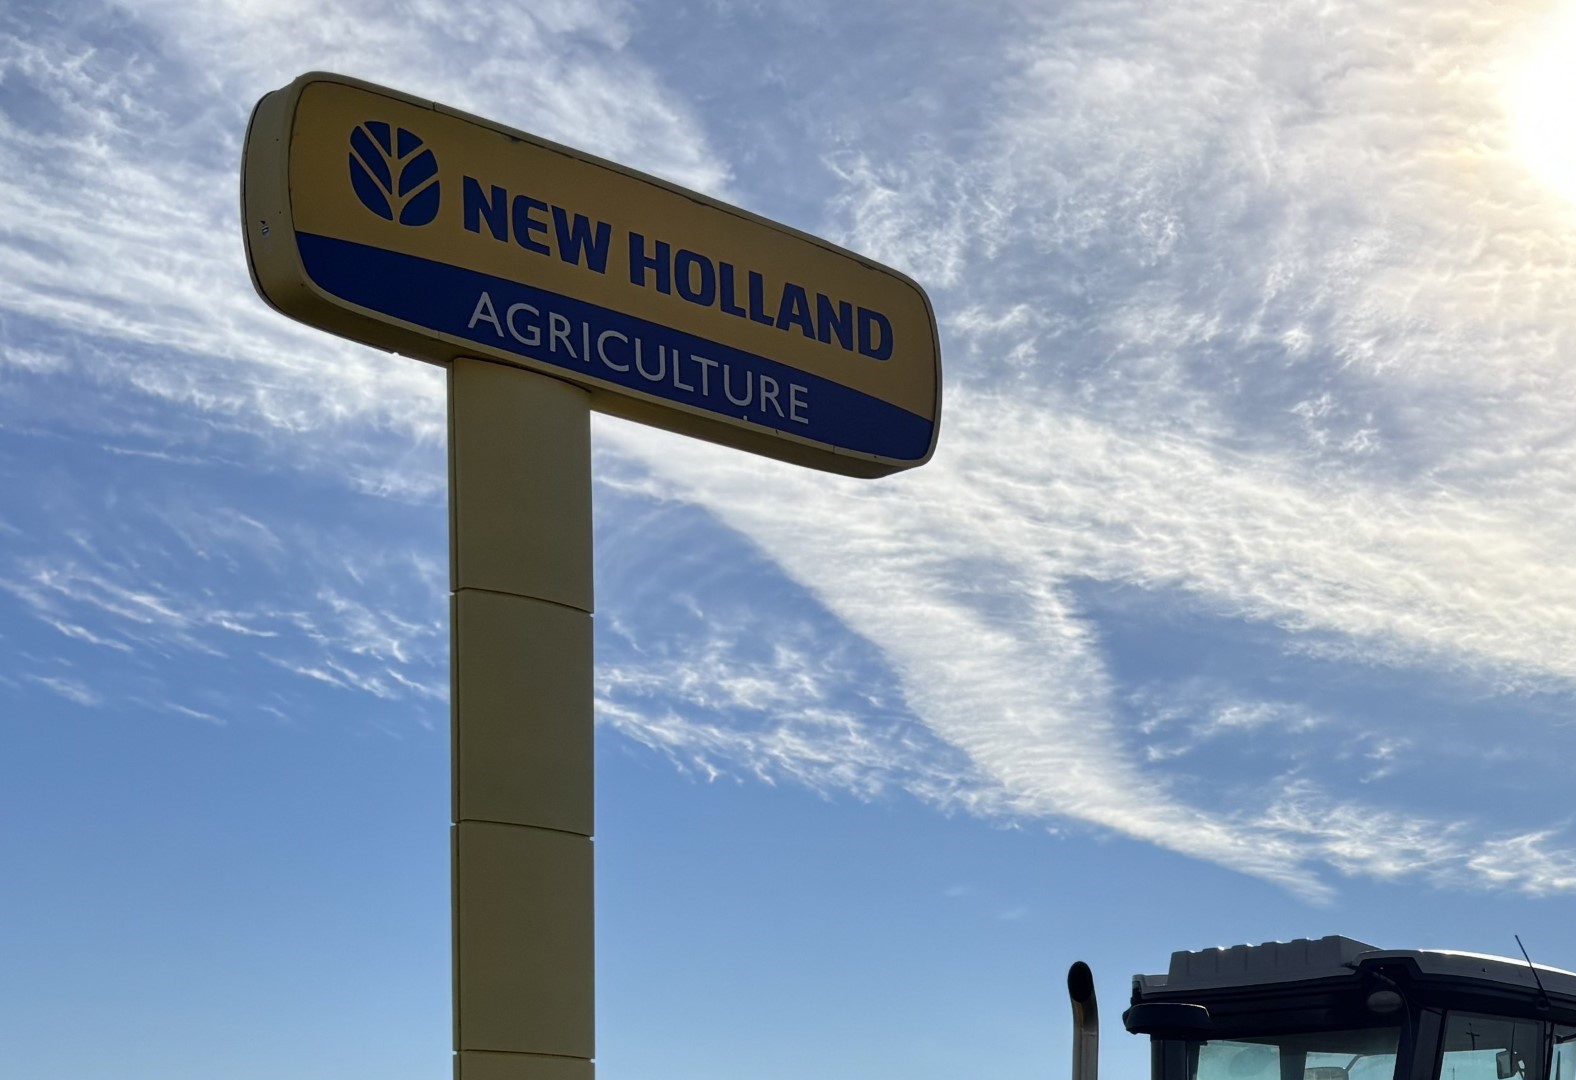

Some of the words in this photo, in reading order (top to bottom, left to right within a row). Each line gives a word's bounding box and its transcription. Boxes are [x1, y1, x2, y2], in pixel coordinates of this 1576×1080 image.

[462, 175, 612, 275] NEW
[628, 231, 894, 361] HOLLAND
[467, 291, 810, 425] AGRICULTURE
